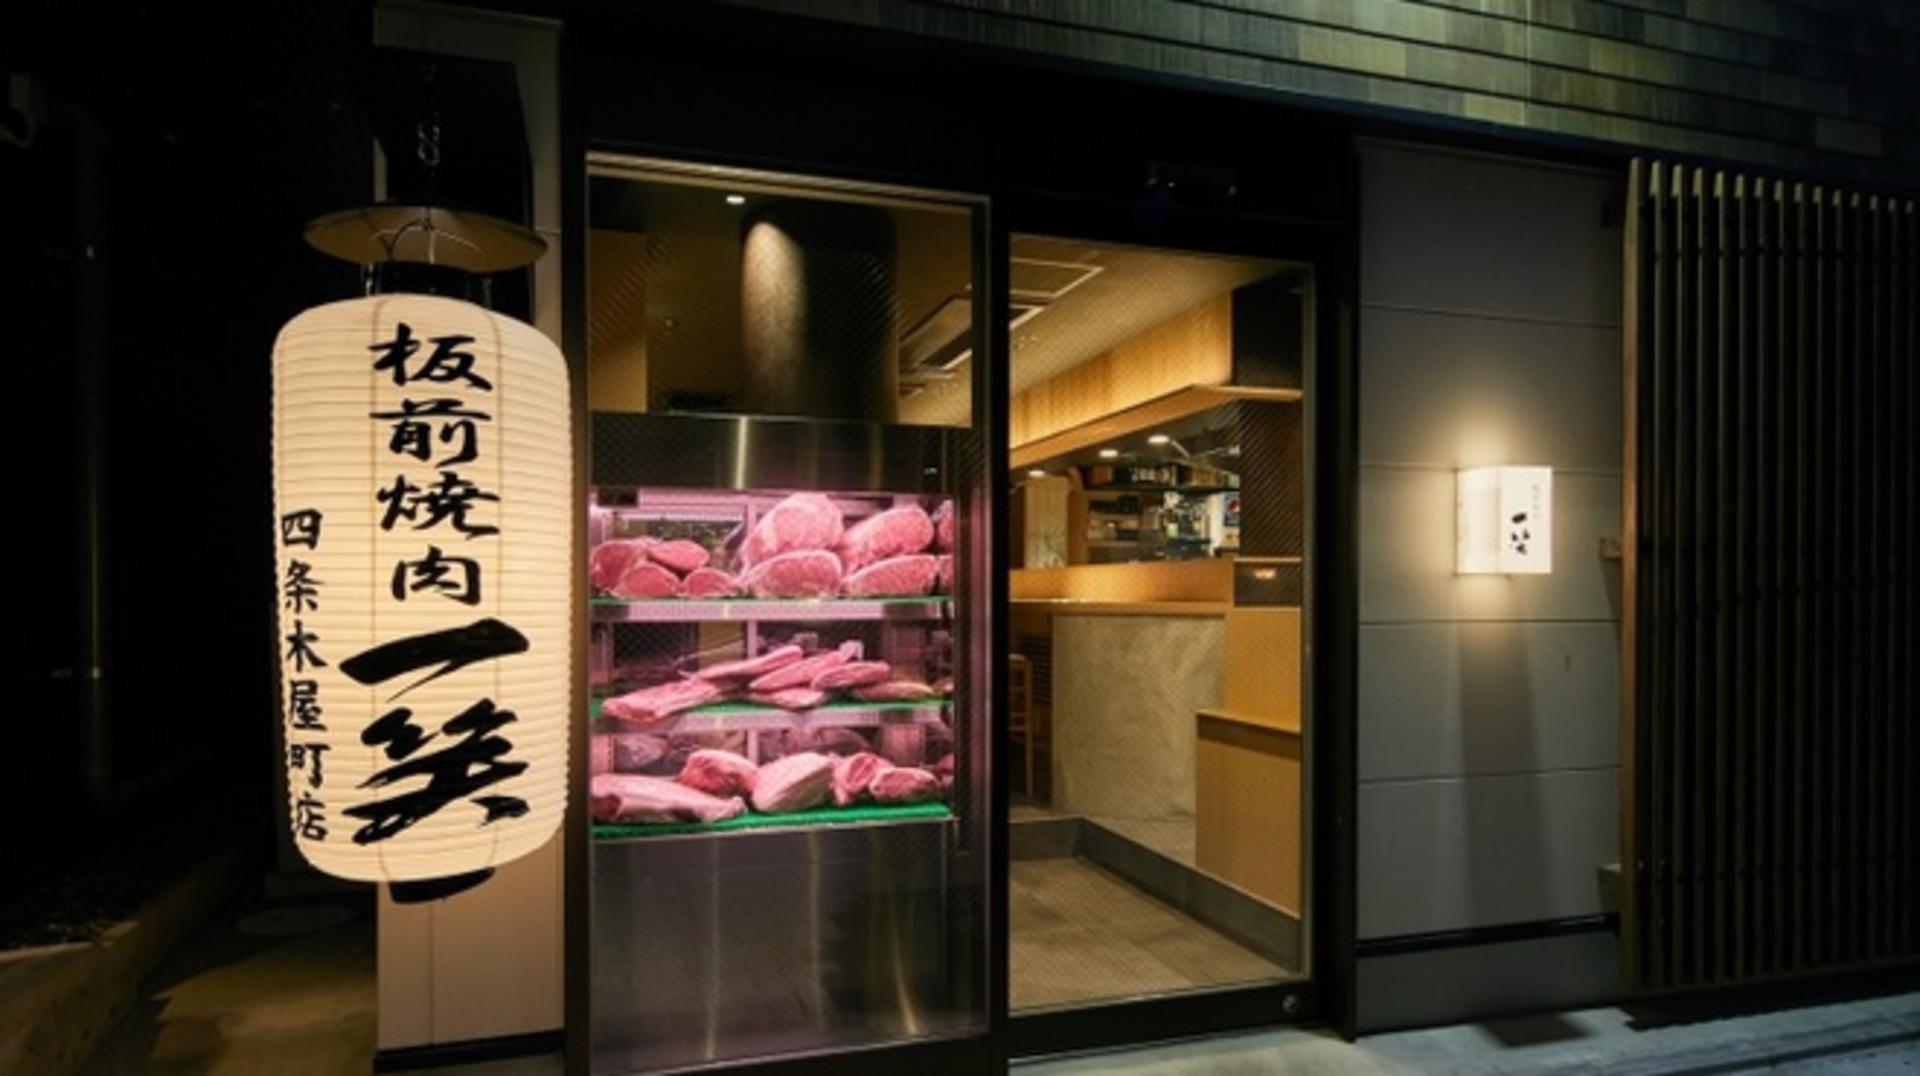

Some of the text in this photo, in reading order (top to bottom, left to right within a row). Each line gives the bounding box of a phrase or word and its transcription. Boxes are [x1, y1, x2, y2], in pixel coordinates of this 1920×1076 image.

[281, 508, 331, 841] 四条木屋町店
